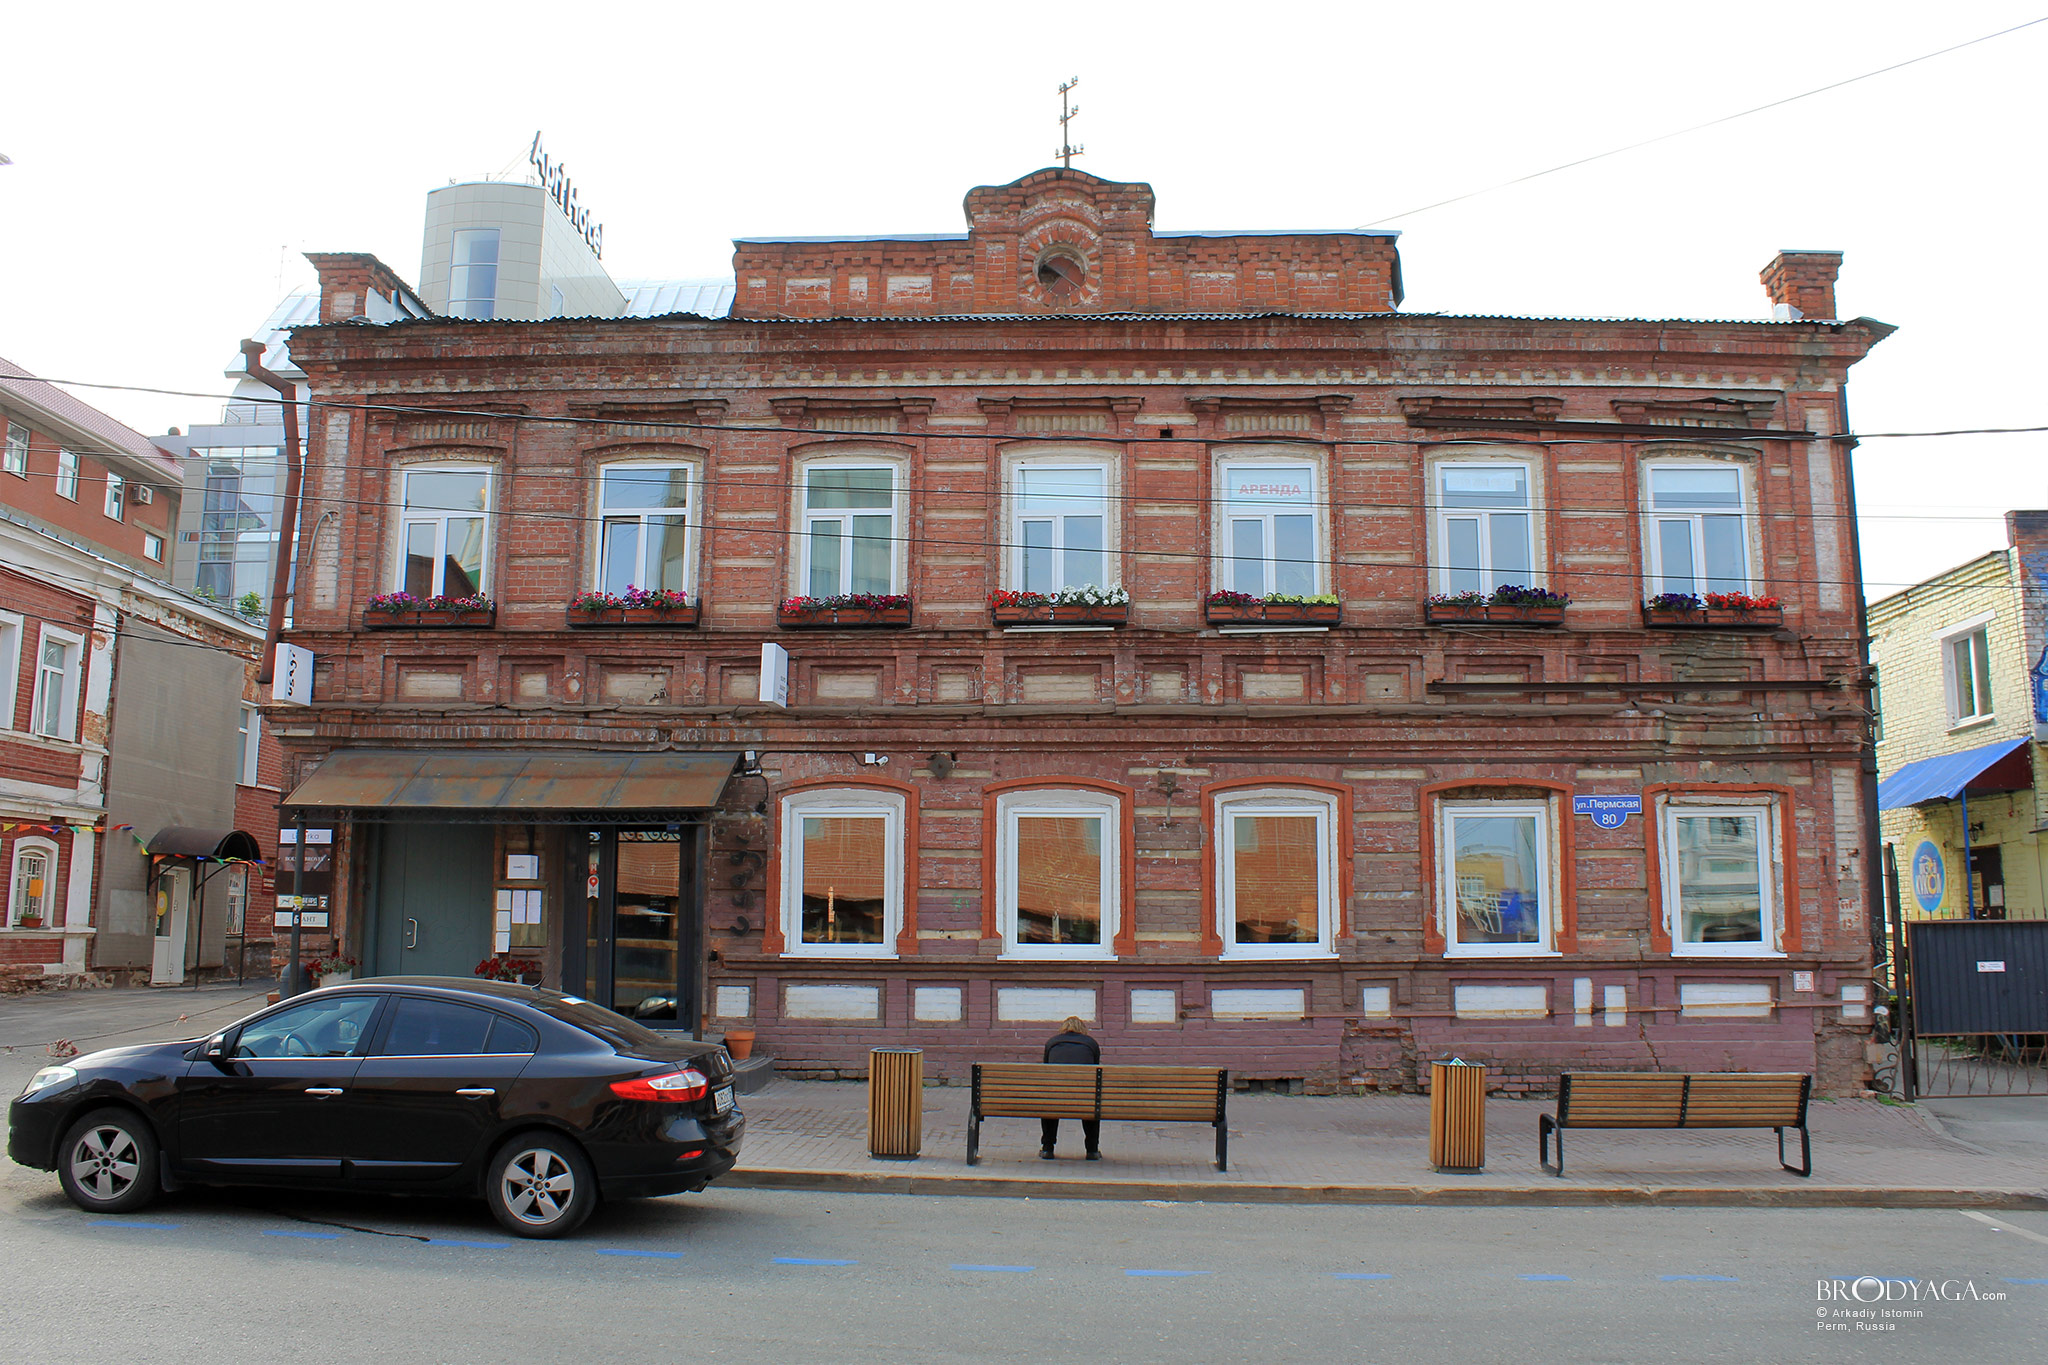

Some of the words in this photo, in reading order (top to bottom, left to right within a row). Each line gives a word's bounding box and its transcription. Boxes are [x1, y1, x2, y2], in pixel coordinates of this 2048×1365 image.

[563, 177, 604, 260] Hotel
[1239, 484, 1301, 497] АРЕНДА
[1602, 813, 1617, 825] 80
